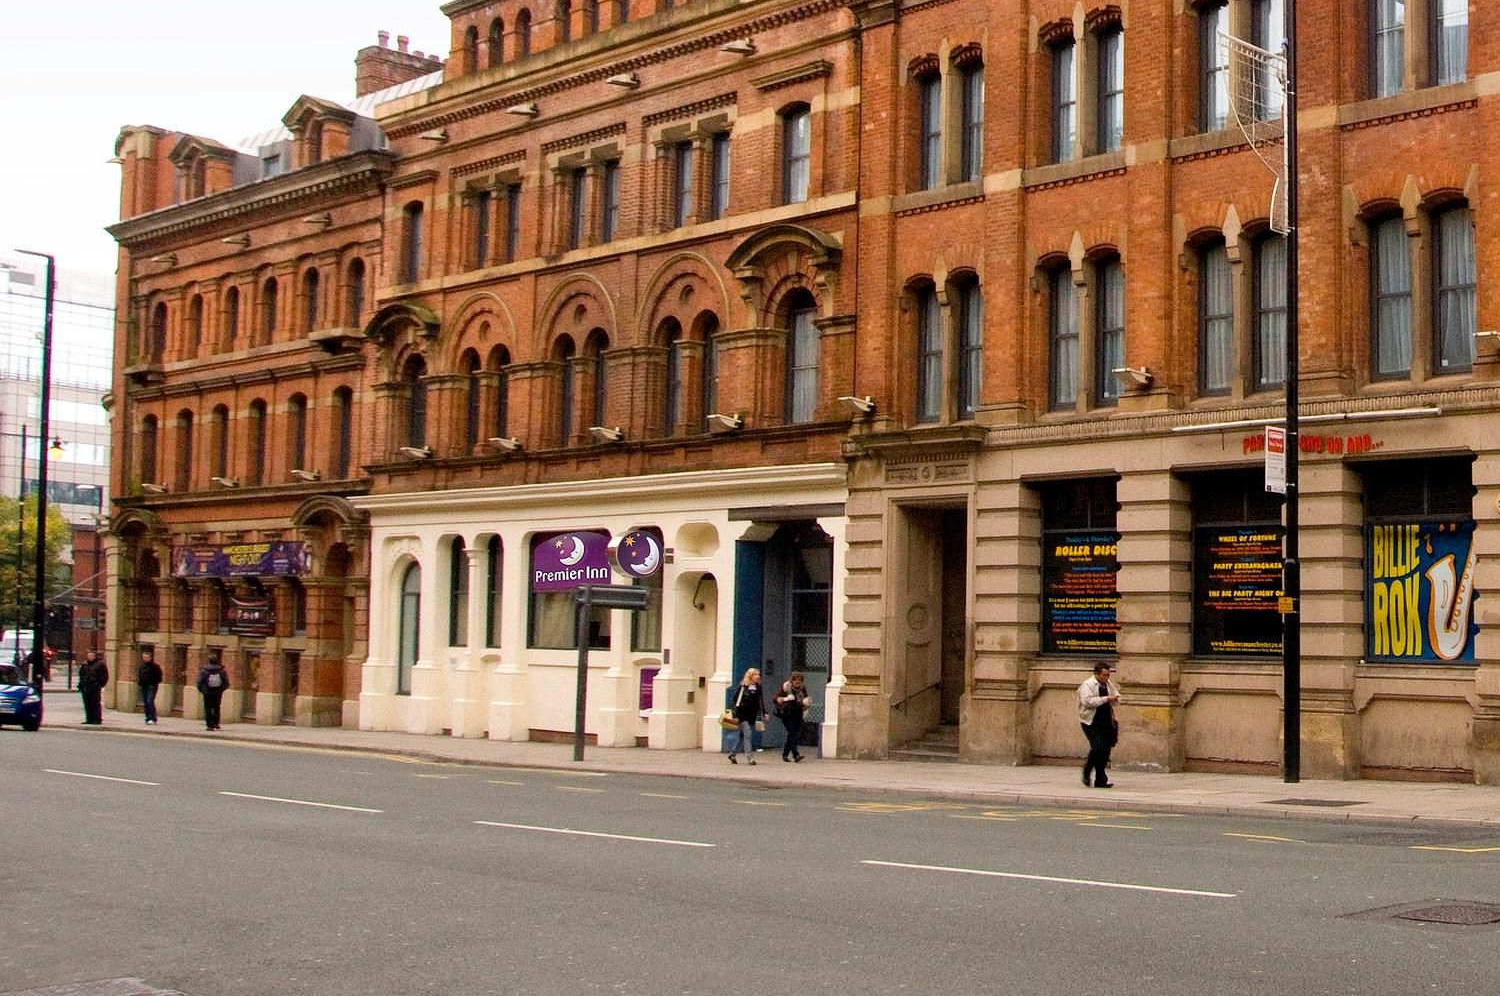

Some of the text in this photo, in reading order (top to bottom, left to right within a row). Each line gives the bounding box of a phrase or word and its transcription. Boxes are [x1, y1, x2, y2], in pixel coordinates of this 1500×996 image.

[1249, 534, 1277, 542] FORTUNE
[1055, 546, 1090, 557] ROLLER
[1374, 525, 1420, 578] BILLIE
[535, 565, 608, 583] Premier Inn
[1374, 571, 1422, 657] ROX
